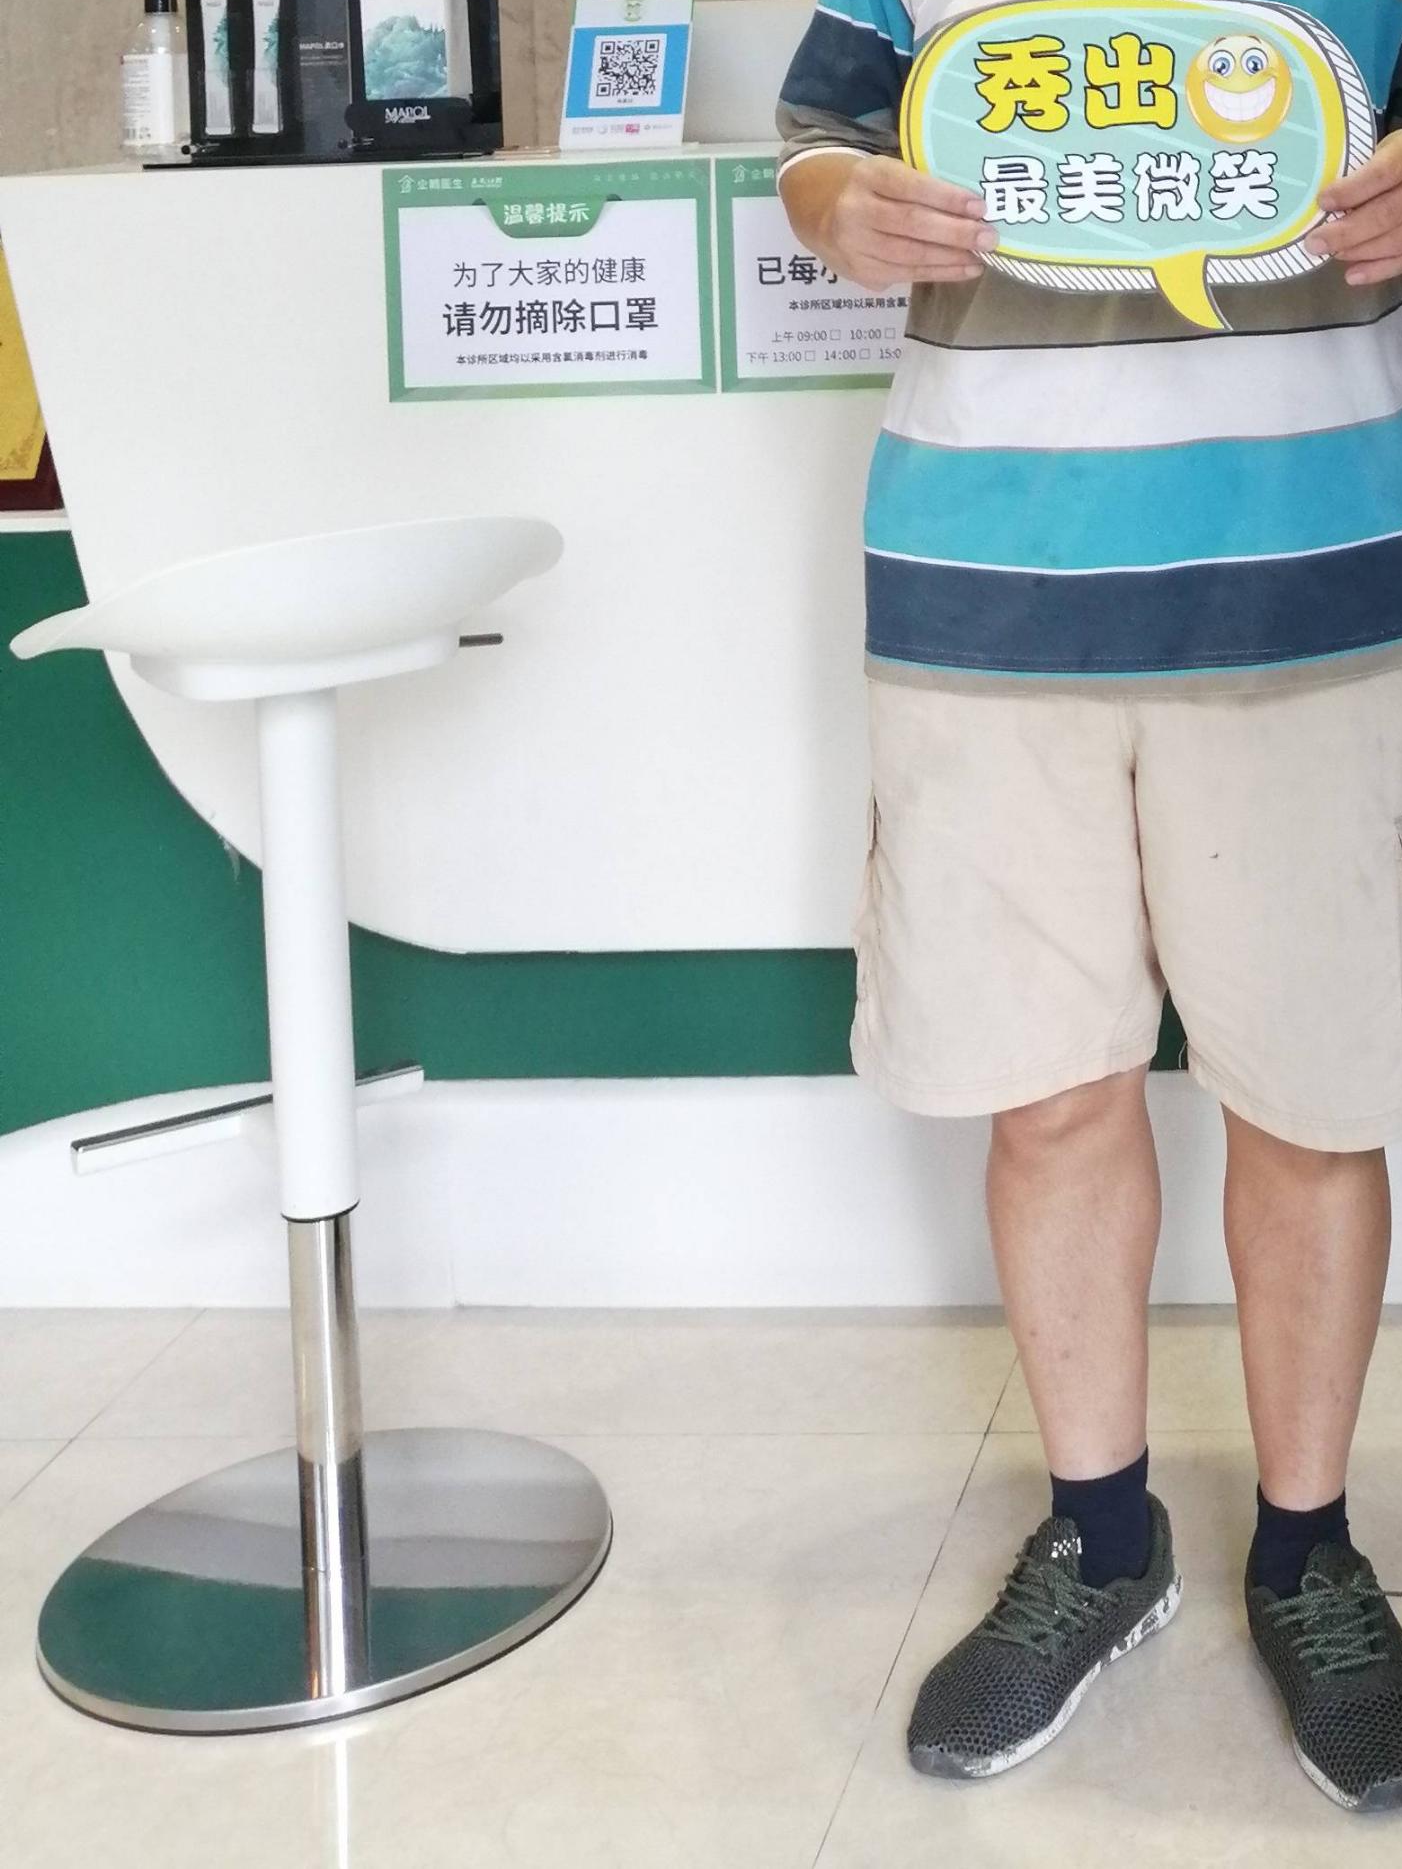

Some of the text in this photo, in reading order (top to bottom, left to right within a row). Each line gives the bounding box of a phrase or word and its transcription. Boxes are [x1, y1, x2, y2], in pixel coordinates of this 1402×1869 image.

[974, 32, 1180, 134] 秀出
[979, 148, 1280, 225] 最美微笑
[503, 202, 590, 226] 温馨提示
[452, 256, 647, 288] 为了大家的健康
[442, 296, 659, 338] 请勿摘除口罩
[788, 296, 911, 311] 本诊所区域均以采用含氯
[772, 331, 794, 344] 上午
[849, 328, 882, 341] 10:00
[824, 349, 857, 361] 14:00
[878, 347, 902, 360] 15:0
